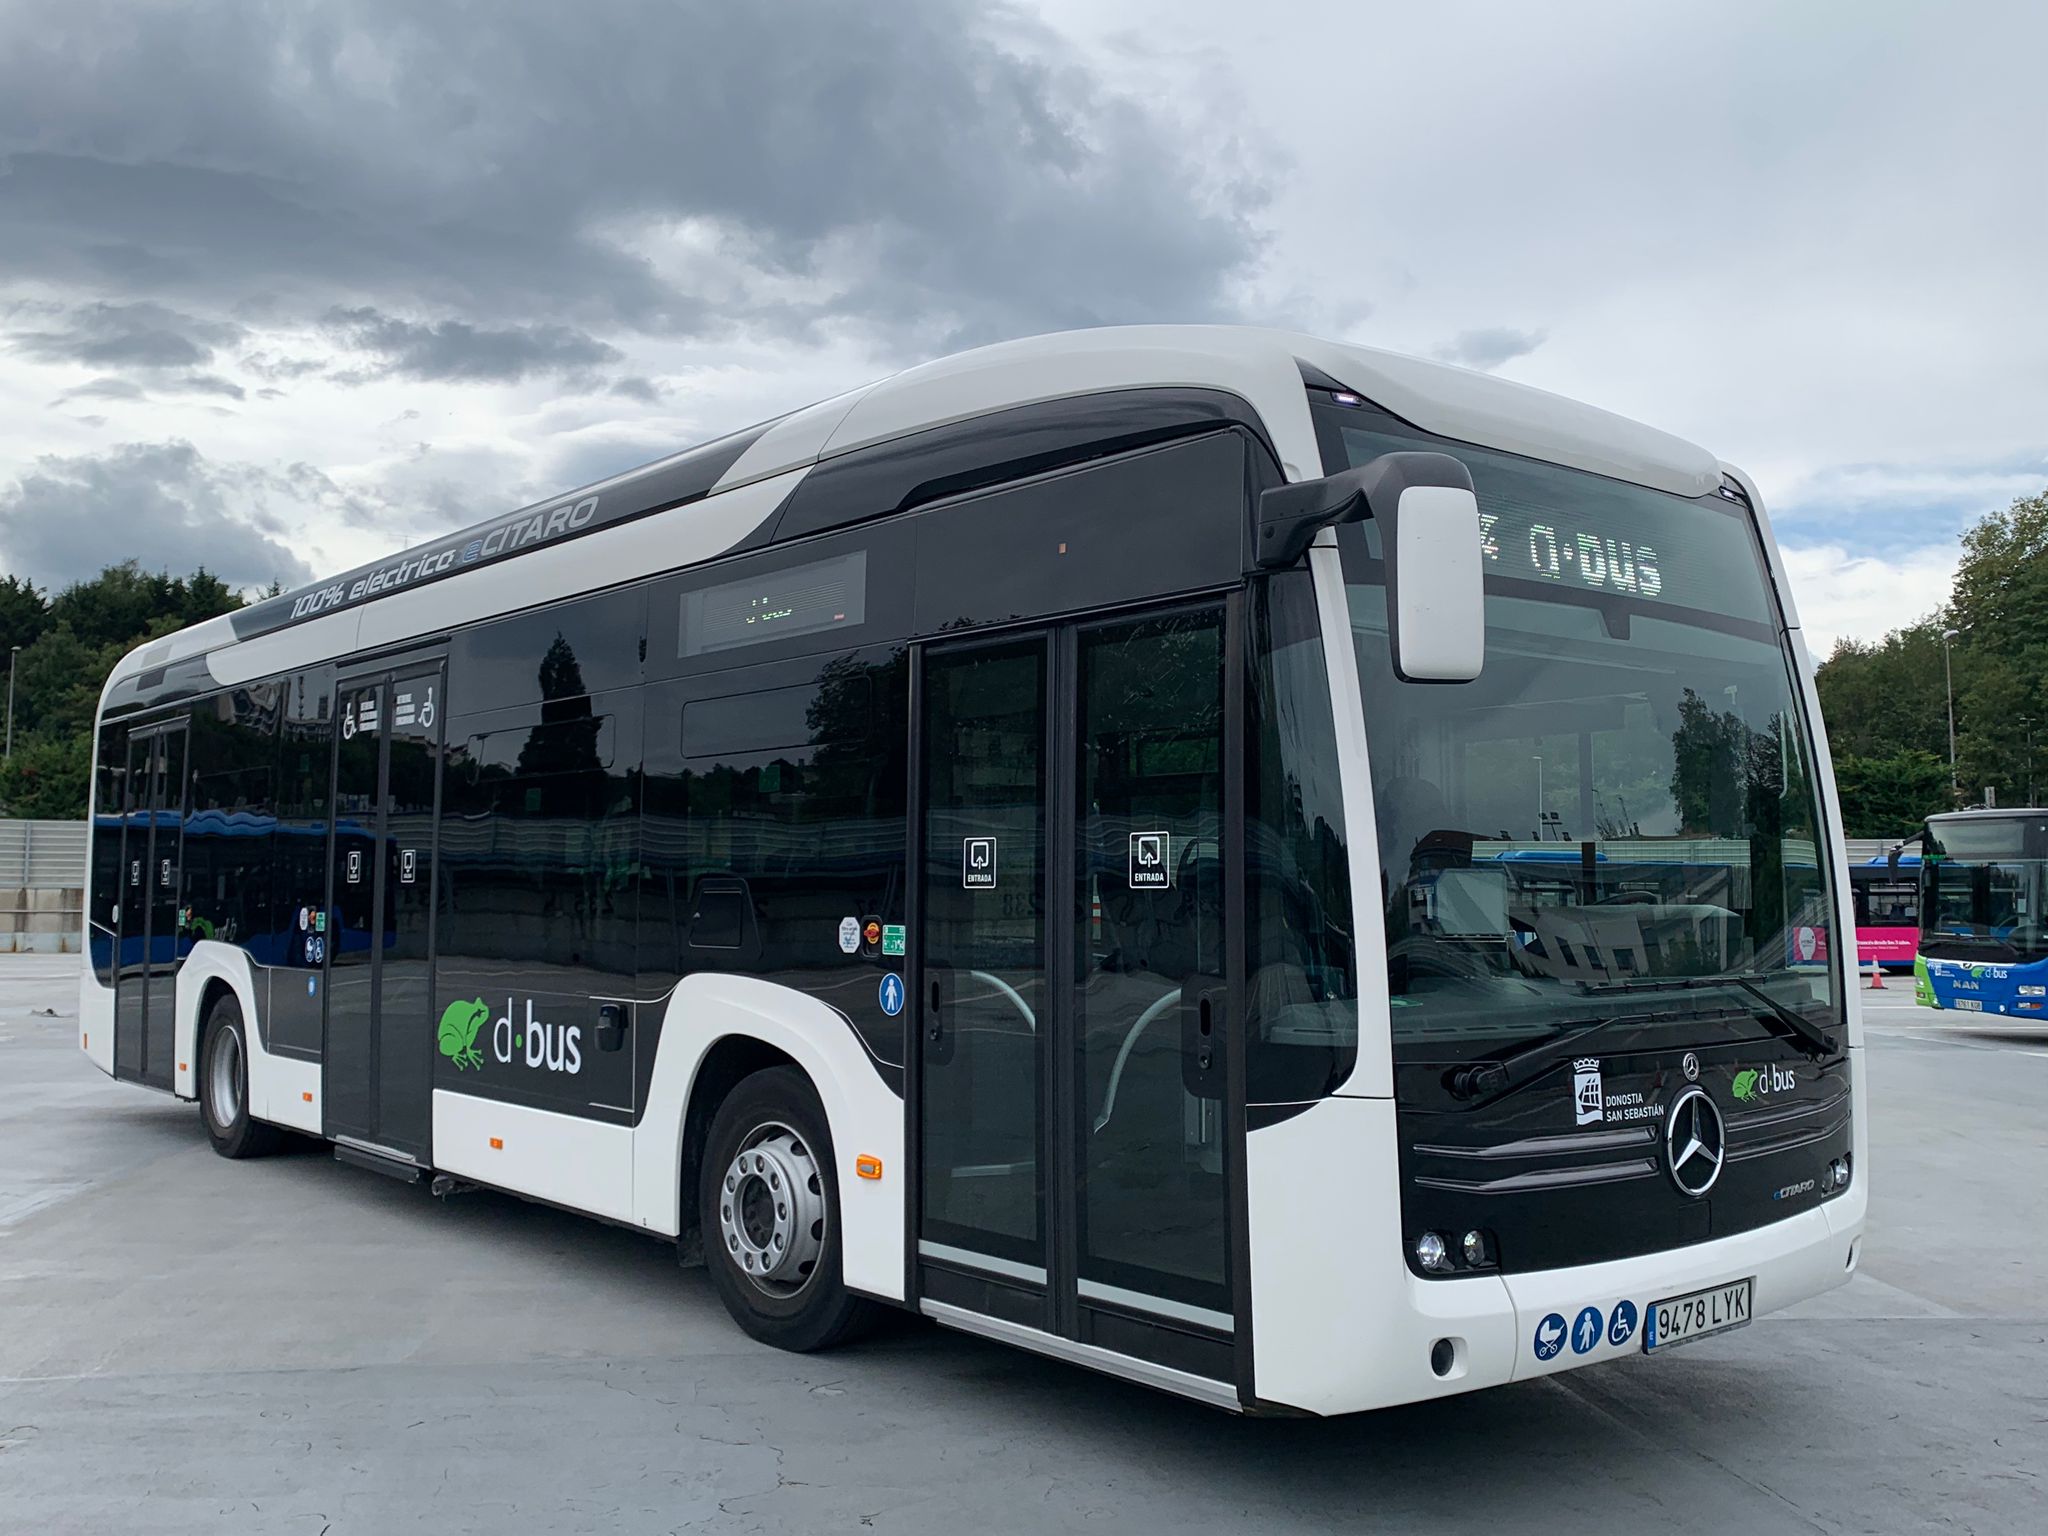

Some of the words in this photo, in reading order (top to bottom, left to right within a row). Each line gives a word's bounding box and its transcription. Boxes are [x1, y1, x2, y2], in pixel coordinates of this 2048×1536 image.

[290, 583, 345, 620] 100%
[348, 549, 456, 601] eléctrico
[968, 874, 992, 883] ENTRADA
[1134, 873, 1164, 882] ENTRADA
[1605, 1093, 1643, 1107] DONOSTIA
[1606, 1109, 1623, 1122] SAN
[1624, 1103, 1664, 1120] SEBASTIÁN
[1659, 1299, 1706, 1339] 9478
[1712, 1287, 1745, 1325] LYK
